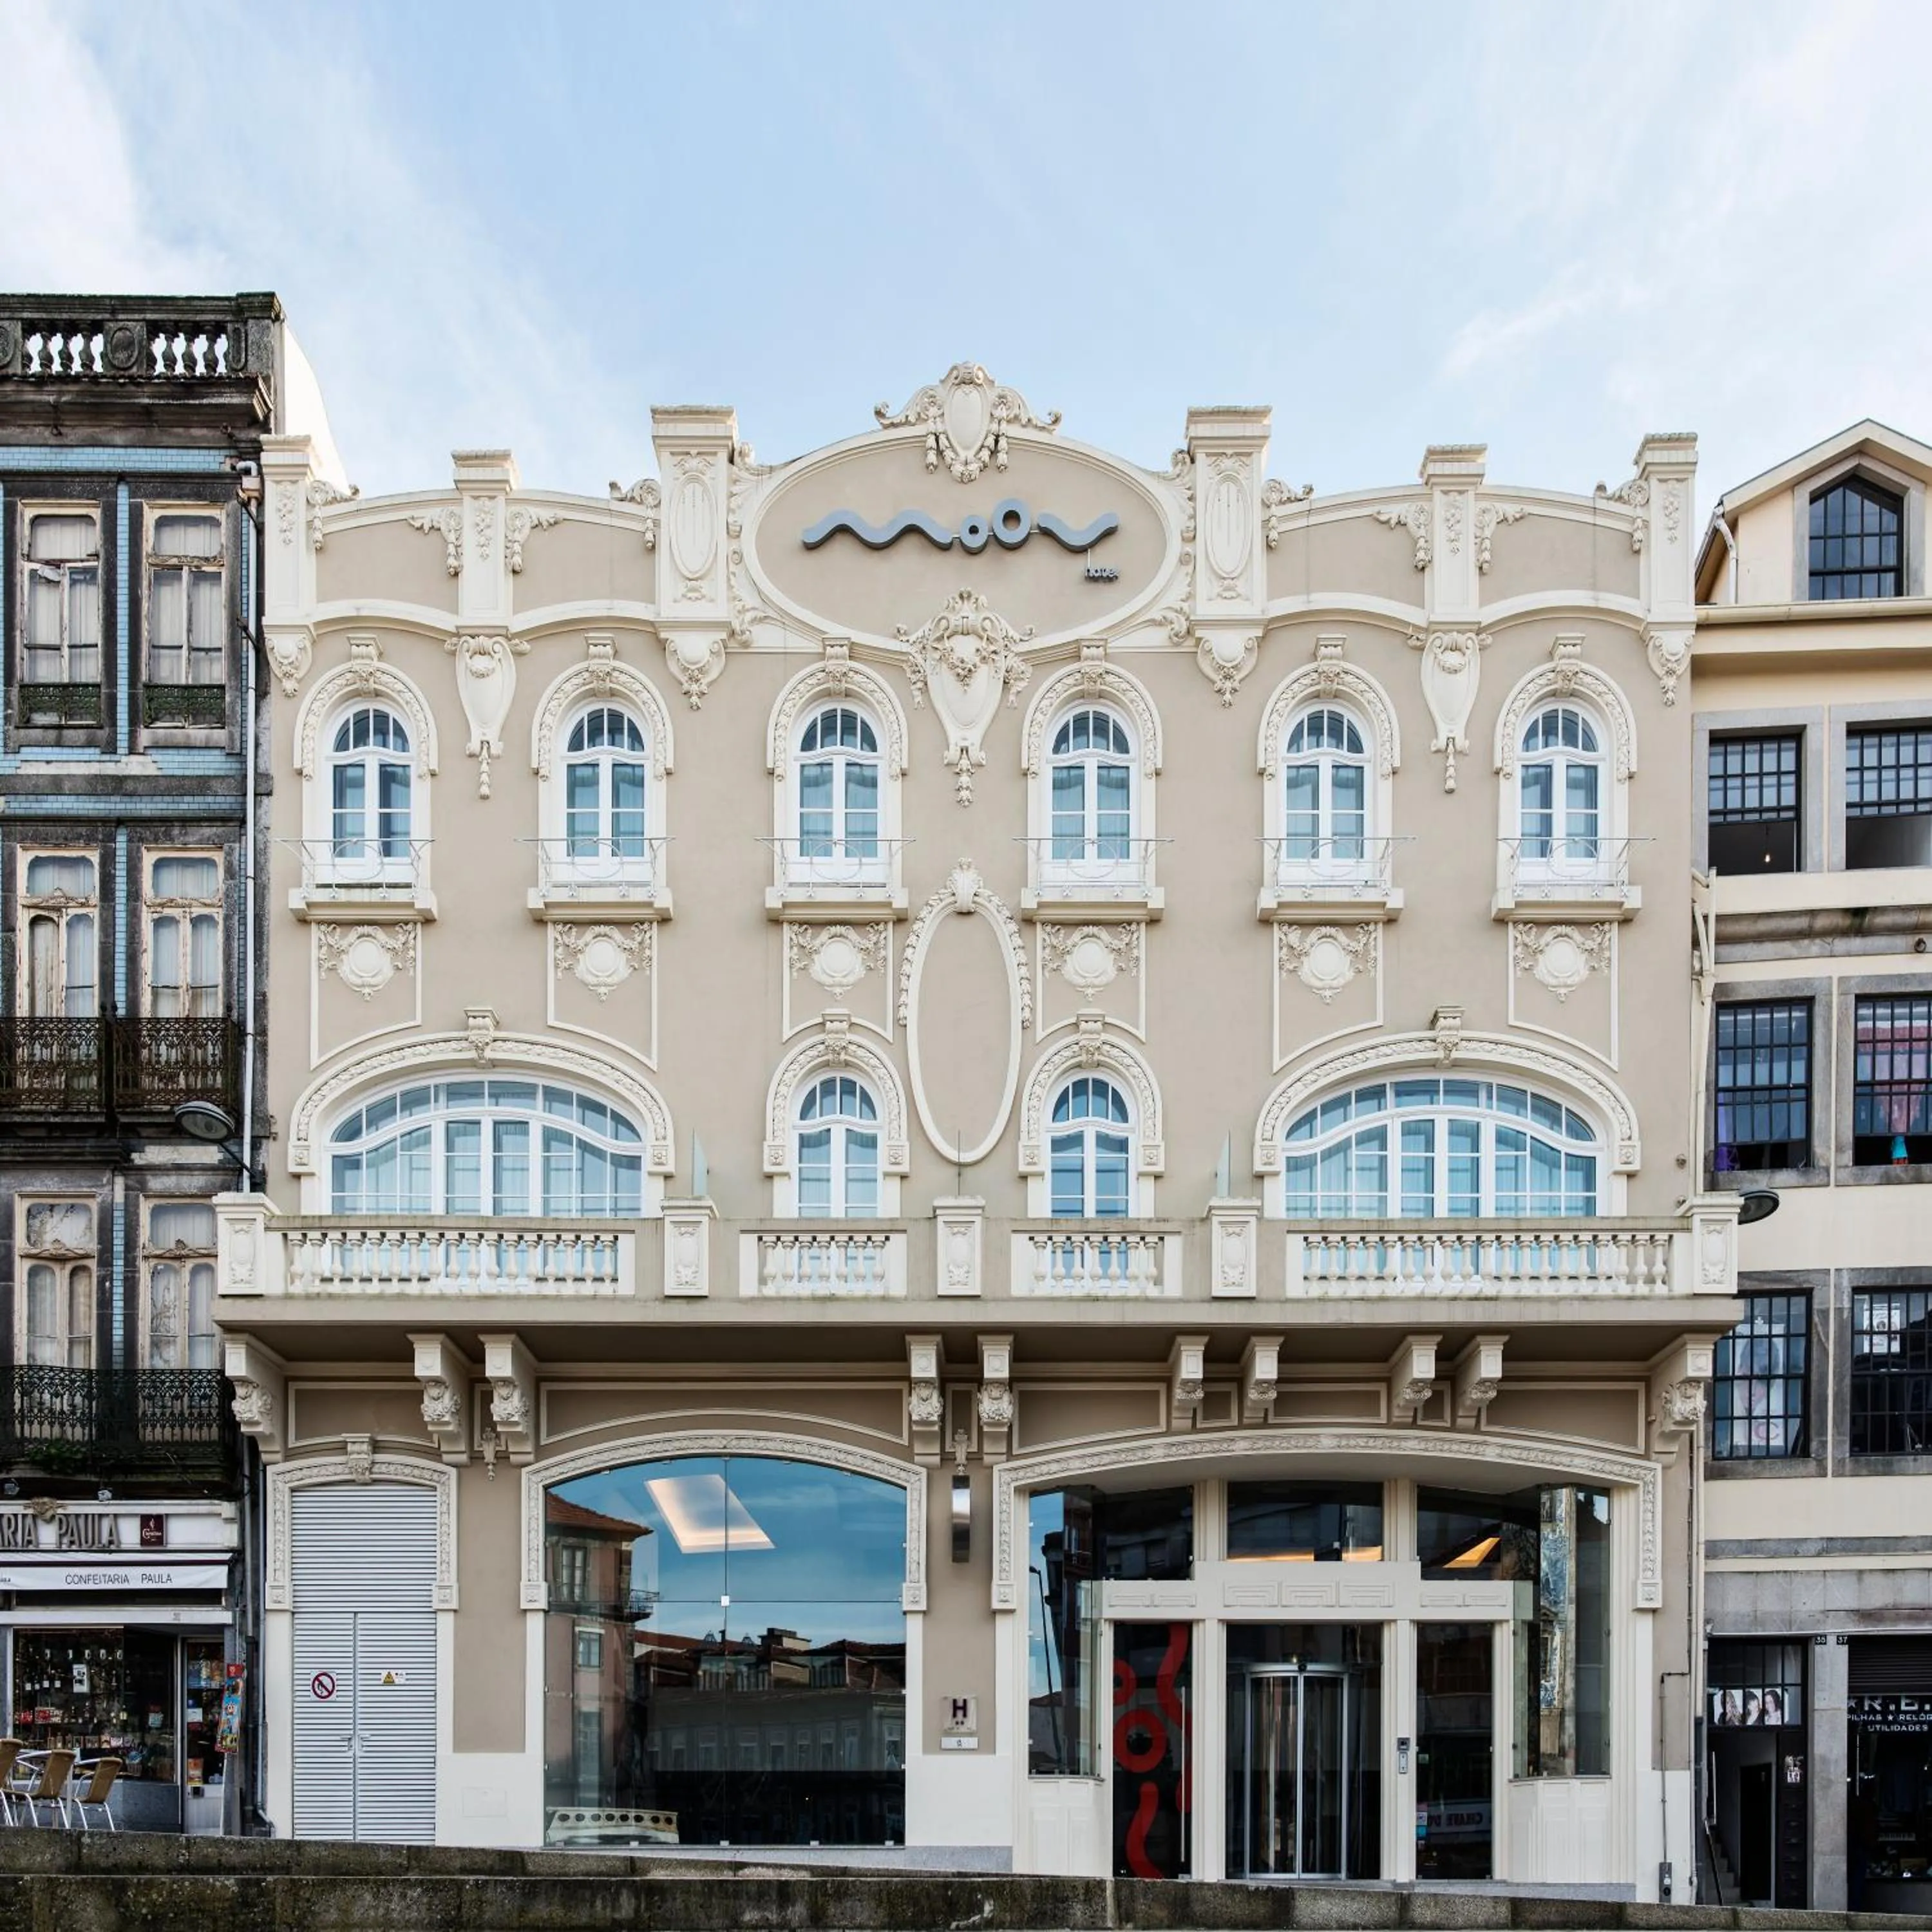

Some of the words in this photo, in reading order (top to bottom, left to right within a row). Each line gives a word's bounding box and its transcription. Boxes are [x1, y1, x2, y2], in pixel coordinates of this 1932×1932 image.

[54, 1513, 121, 1549] PAULA
[65, 1573, 129, 1586] CONFEITARIA
[141, 1573, 173, 1584] PAULA
[1837, 1636, 1848, 1644] 37
[952, 1698, 967, 1718] H
